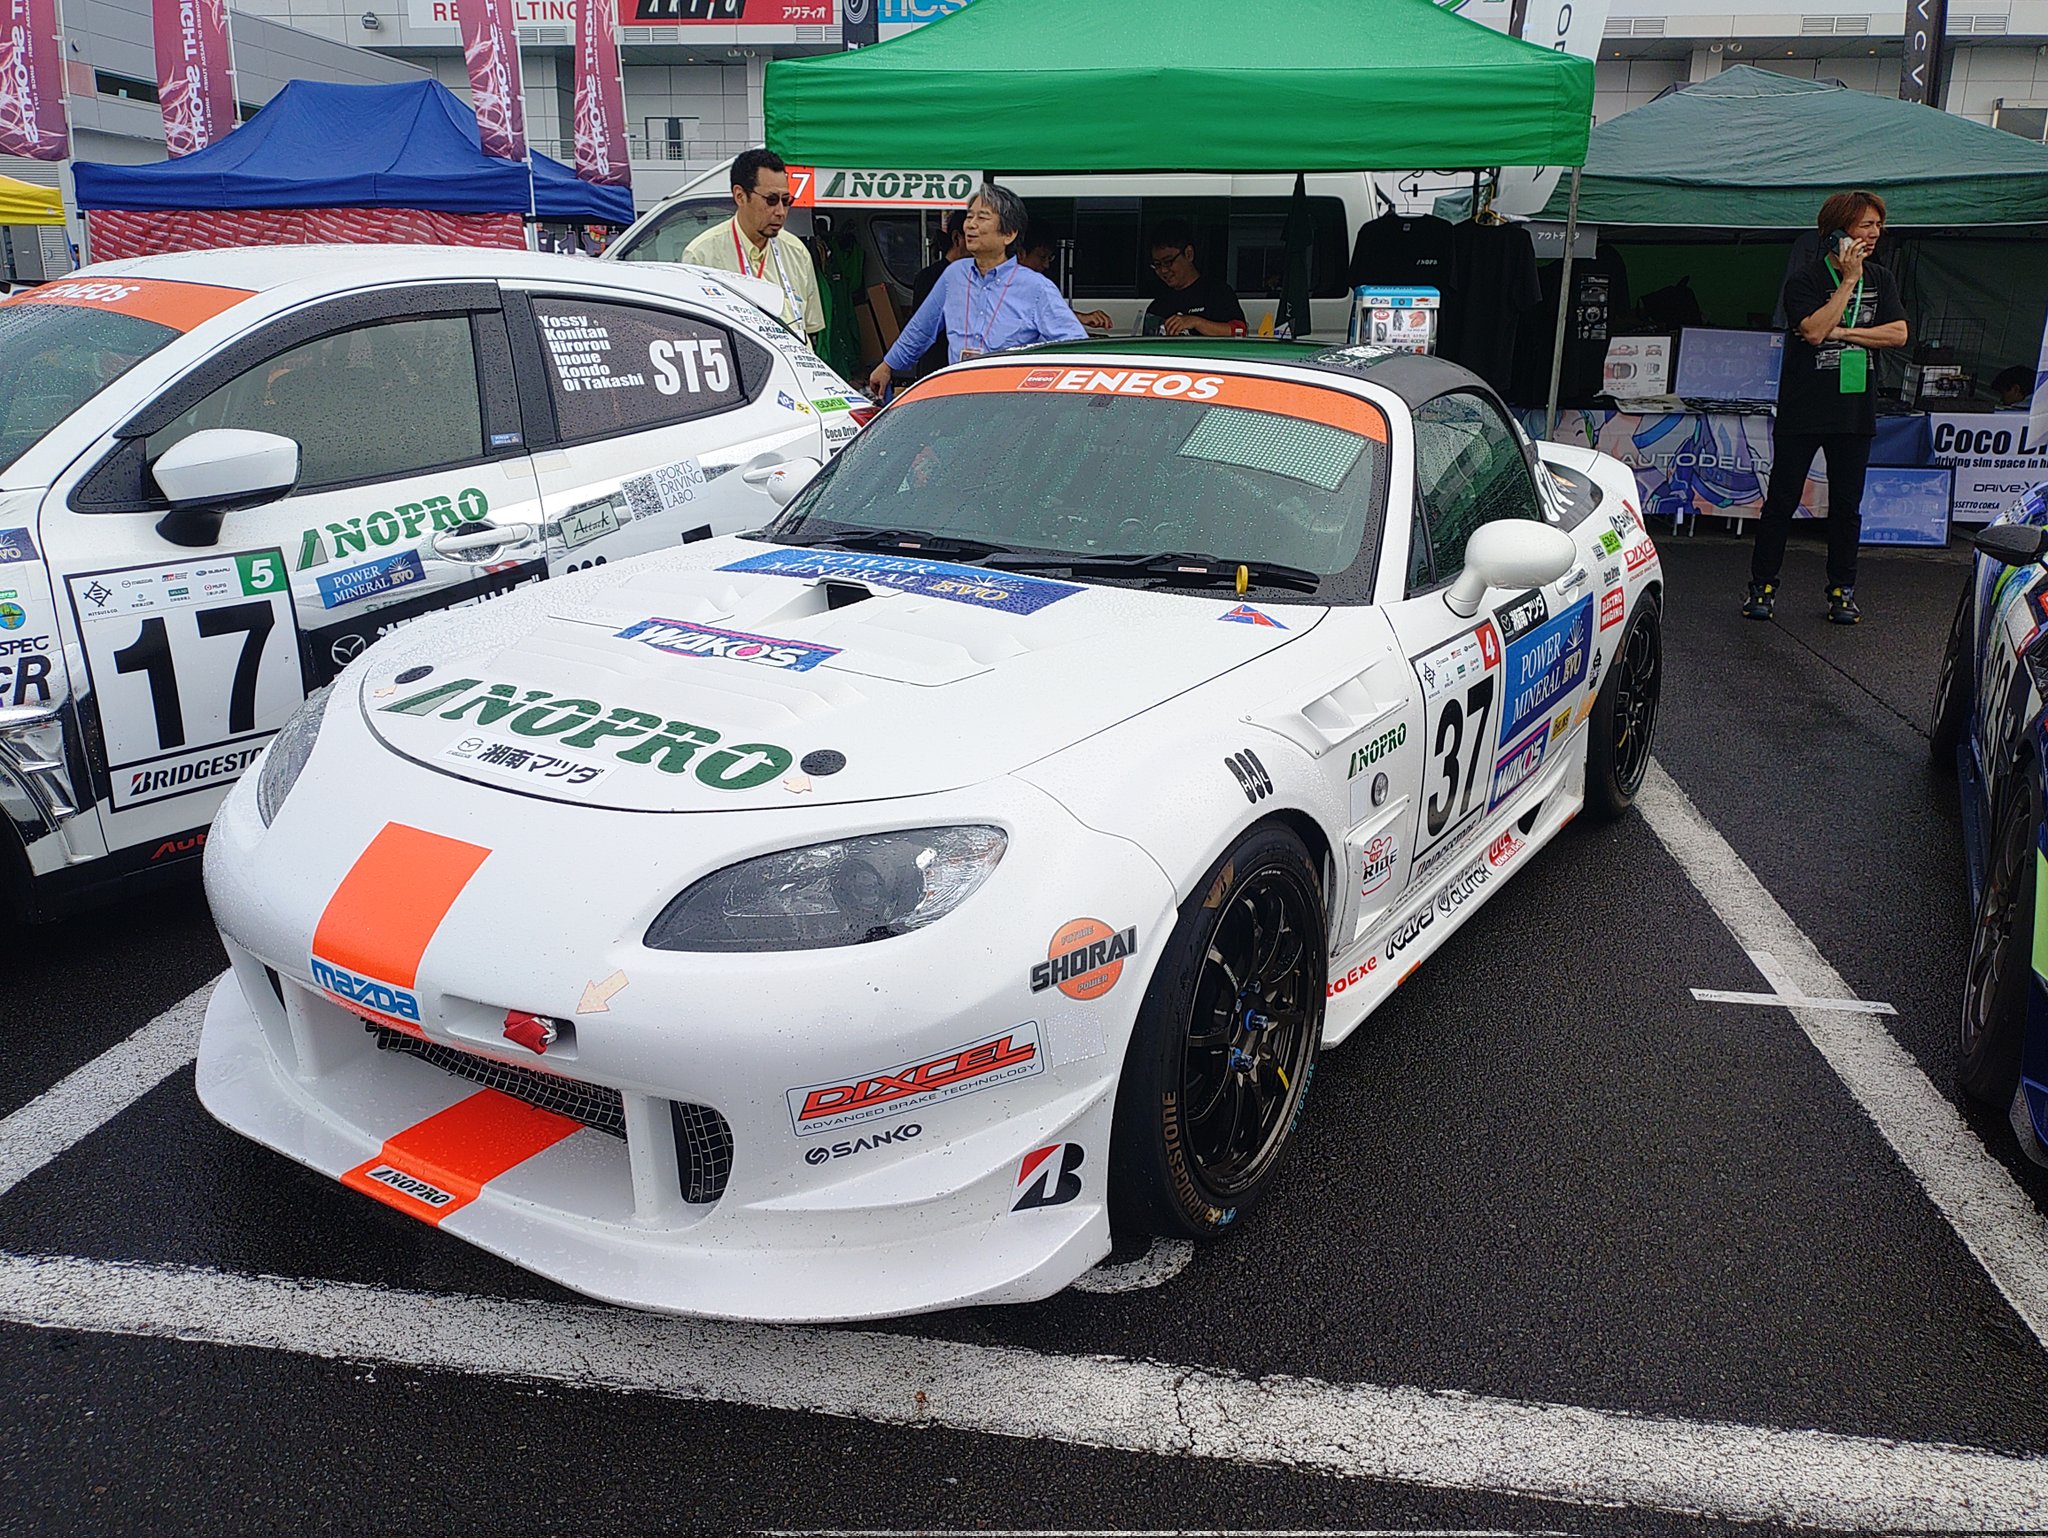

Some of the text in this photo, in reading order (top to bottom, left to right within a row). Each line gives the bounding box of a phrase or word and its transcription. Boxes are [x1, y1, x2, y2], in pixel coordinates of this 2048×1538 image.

[782, 6, 827, 19] アクティオ
[850, 172, 973, 199] NOPRO
[42, 283, 141, 302] ENEOS
[538, 314, 588, 328] Yossy
[544, 327, 608, 341] Konitan
[548, 338, 611, 353] Hirorou
[553, 352, 602, 366] Inoue
[558, 364, 611, 377] Kondo
[562, 372, 645, 391] Oi Takashi
[648, 338, 731, 396] ST5
[1054, 369, 1226, 400] ENEOS
[1933, 422, 2012, 455] Coco
[655, 460, 693, 483] SPORTS
[1972, 456, 1993, 468] sim
[1993, 458, 2026, 469] space
[661, 470, 704, 496] DRIVING
[666, 489, 696, 509] LABO.
[324, 487, 489, 559] NOPRO
[250, 558, 275, 590] 5
[333, 565, 381, 589] POWER
[758, 560, 922, 588] MINERAL
[800, 552, 940, 576] POWER
[333, 577, 390, 603] MINERAL
[1510, 594, 1546, 633] 湘南マツダ
[1484, 629, 1496, 661] 4
[1520, 631, 1562, 686] POWER
[113, 599, 275, 750] 17
[1511, 670, 1562, 725] MINERAL
[438, 684, 794, 791] NOPRO
[1358, 722, 1408, 772] NOPRO
[477, 743, 605, 784] 湘南マツダ
[1427, 673, 1495, 838] 37
[1363, 848, 1399, 881] RIDE
[1450, 863, 1493, 905] CLUTCH
[1031, 928, 1137, 992] SHORAI
[1076, 974, 1110, 994] POWER
[798, 1035, 1037, 1119] DIXCEL
[801, 1063, 1037, 1132] ADVANCED BRAKE TECHNOLOGY
[831, 1122, 923, 1159] SANKO
